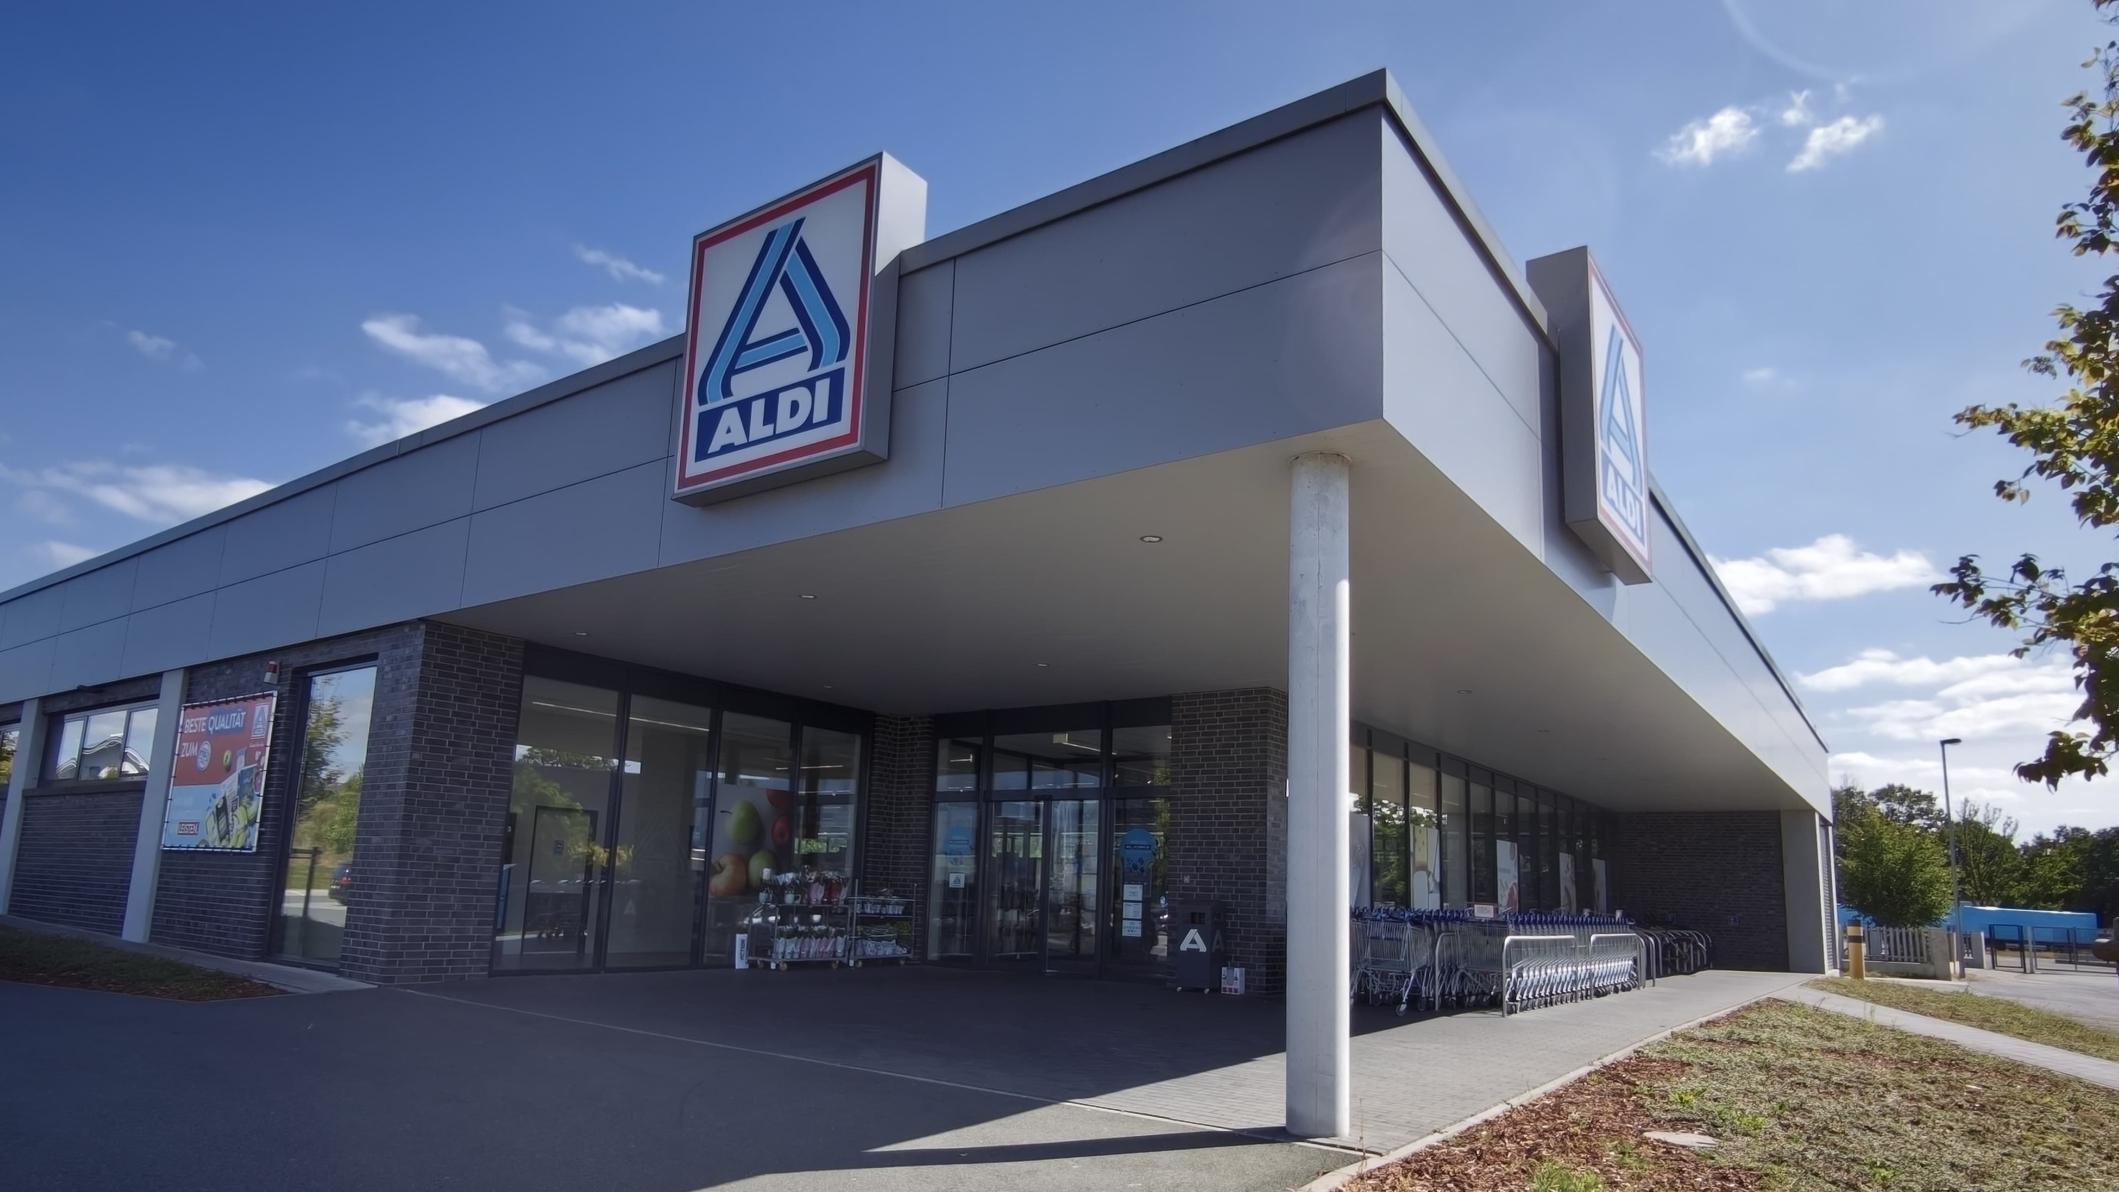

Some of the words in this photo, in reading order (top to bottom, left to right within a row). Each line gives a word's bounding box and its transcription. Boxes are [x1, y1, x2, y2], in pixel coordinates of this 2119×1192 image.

[707, 377, 831, 454] ALDI
[1606, 462, 1642, 540] ALDI
[184, 716, 208, 734] BESTE
[208, 708, 246, 735] QUALITÄT
[180, 741, 198, 758] ZUM
